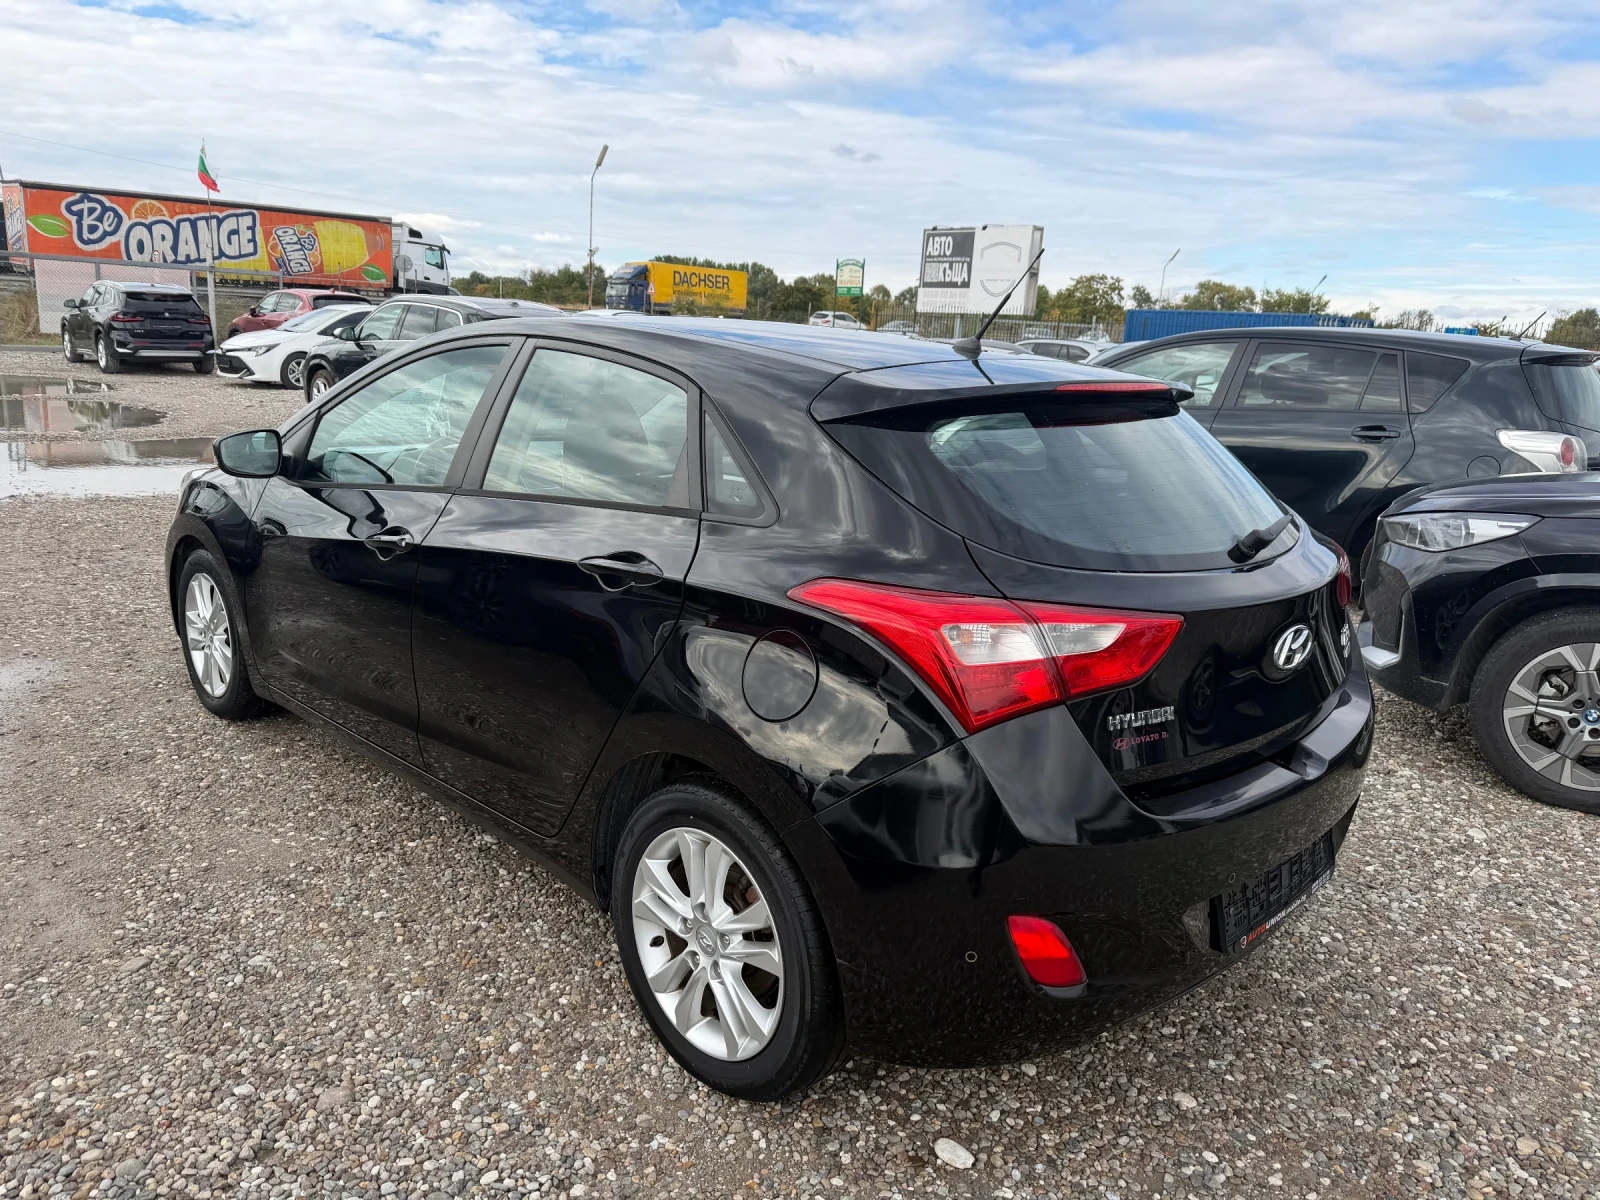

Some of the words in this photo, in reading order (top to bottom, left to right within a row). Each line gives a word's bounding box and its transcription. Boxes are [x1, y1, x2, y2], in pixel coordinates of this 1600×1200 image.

[65, 196, 121, 246] Be
[124, 212, 259, 264] ORANGE
[274, 227, 313, 273] ORANGE
[926, 236, 953, 256] АВТО
[673, 270, 730, 290] DACHSER
[1107, 705, 1175, 731] HYUNDAI
[1131, 734, 1161, 745] LOVATO
